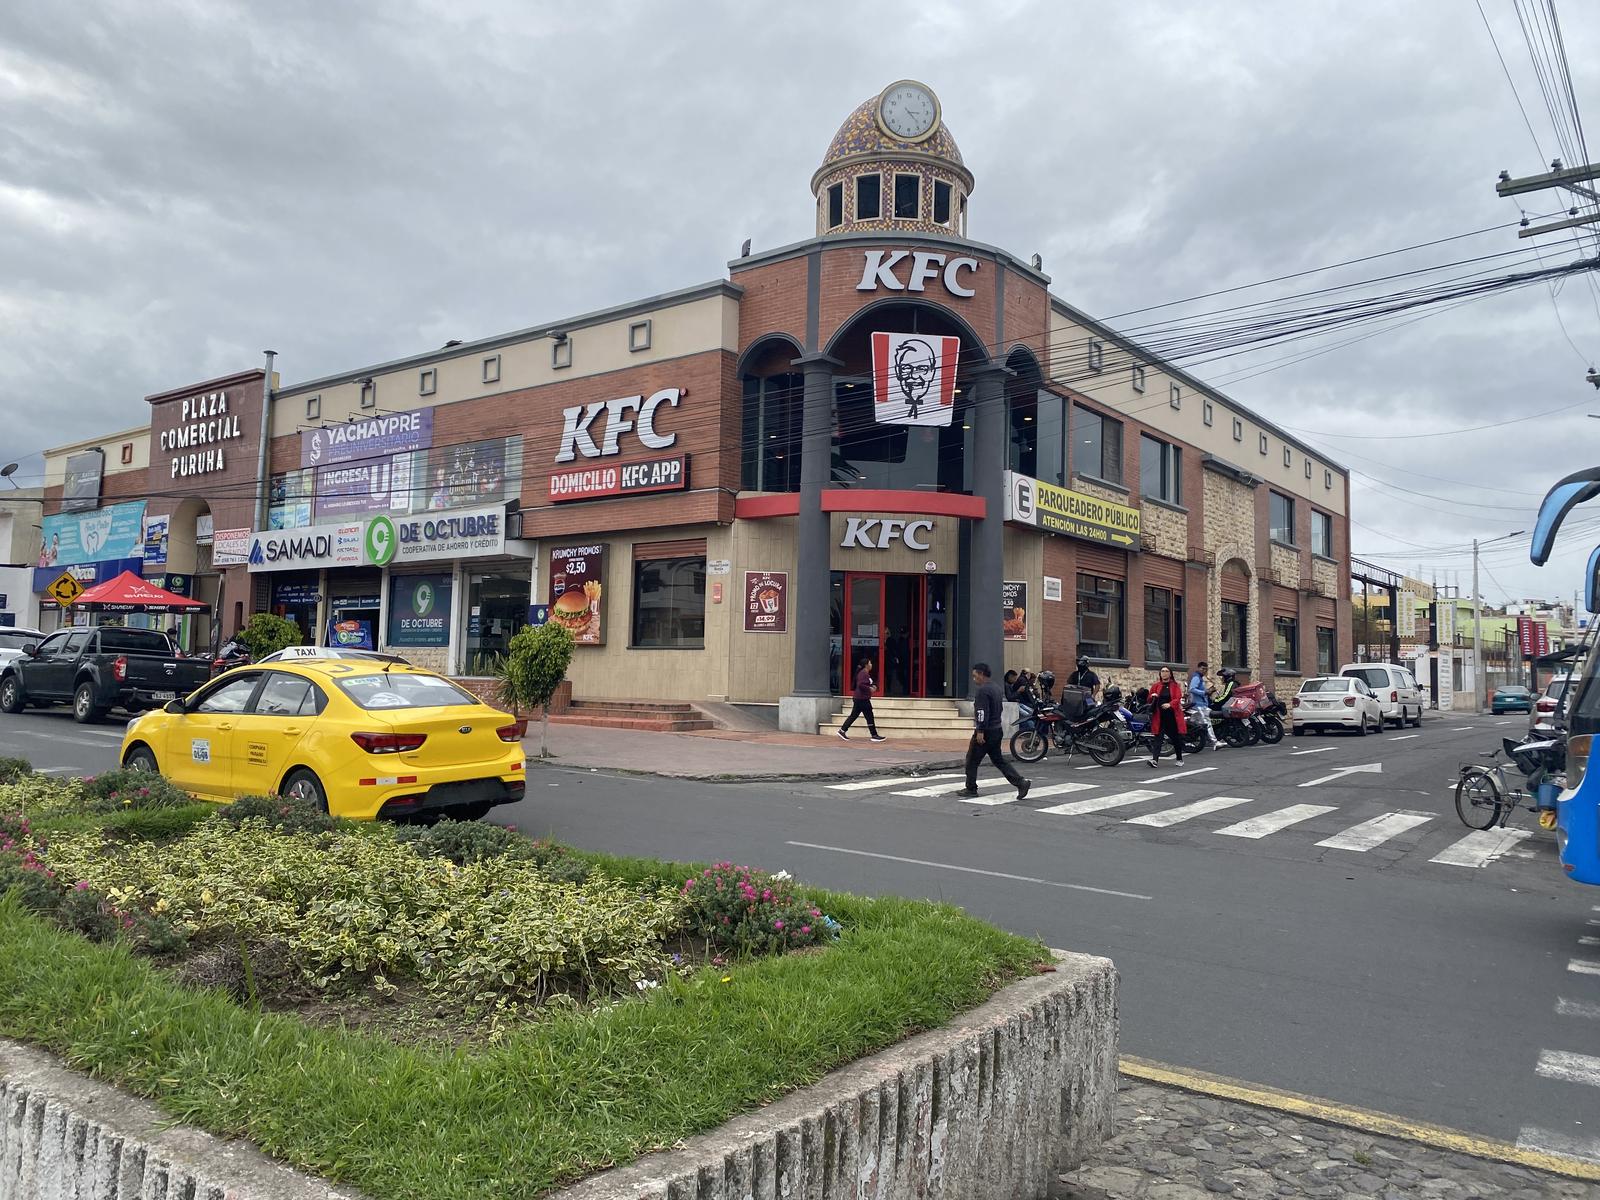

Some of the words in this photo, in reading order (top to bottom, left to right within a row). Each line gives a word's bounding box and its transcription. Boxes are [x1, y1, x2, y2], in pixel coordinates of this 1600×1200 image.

[856, 250, 978, 298] KFC
[182, 392, 226, 421] PLAZA
[160, 415, 241, 450] COMERCIAL
[327, 412, 420, 445] YACHAYPRE
[555, 388, 680, 463] KFC
[328, 431, 420, 456] PREUNIVERSITARIO
[171, 448, 225, 478] PURUHA
[324, 467, 370, 486] INGRESA
[551, 468, 616, 495] DOMICILIO
[622, 465, 648, 487] KFC
[651, 461, 680, 484] APP
[1018, 484, 1030, 514] E
[1039, 488, 1103, 522] PARQUEADERO
[1105, 506, 1139, 530] PÚBLICO
[400, 523, 420, 543] DE
[424, 514, 498, 540] OCTUBRE
[840, 518, 933, 550] KFC
[1042, 514, 1075, 532] ATENCIÓN
[1076, 523, 1088, 536] LAS
[1089, 527, 1107, 541] 24H00
[266, 534, 331, 561] SAMADI
[402, 544, 437, 554] COOPERATIVA
[437, 543, 446, 552] DE
[446, 541, 469, 551] AHORRO
[552, 548, 577, 561] KRUNCHY
[578, 545, 600, 557] PROMOS
[401, 619, 411, 628] DE
[412, 618, 443, 628] OCTUBRE
[294, 648, 317, 657] TAXI
